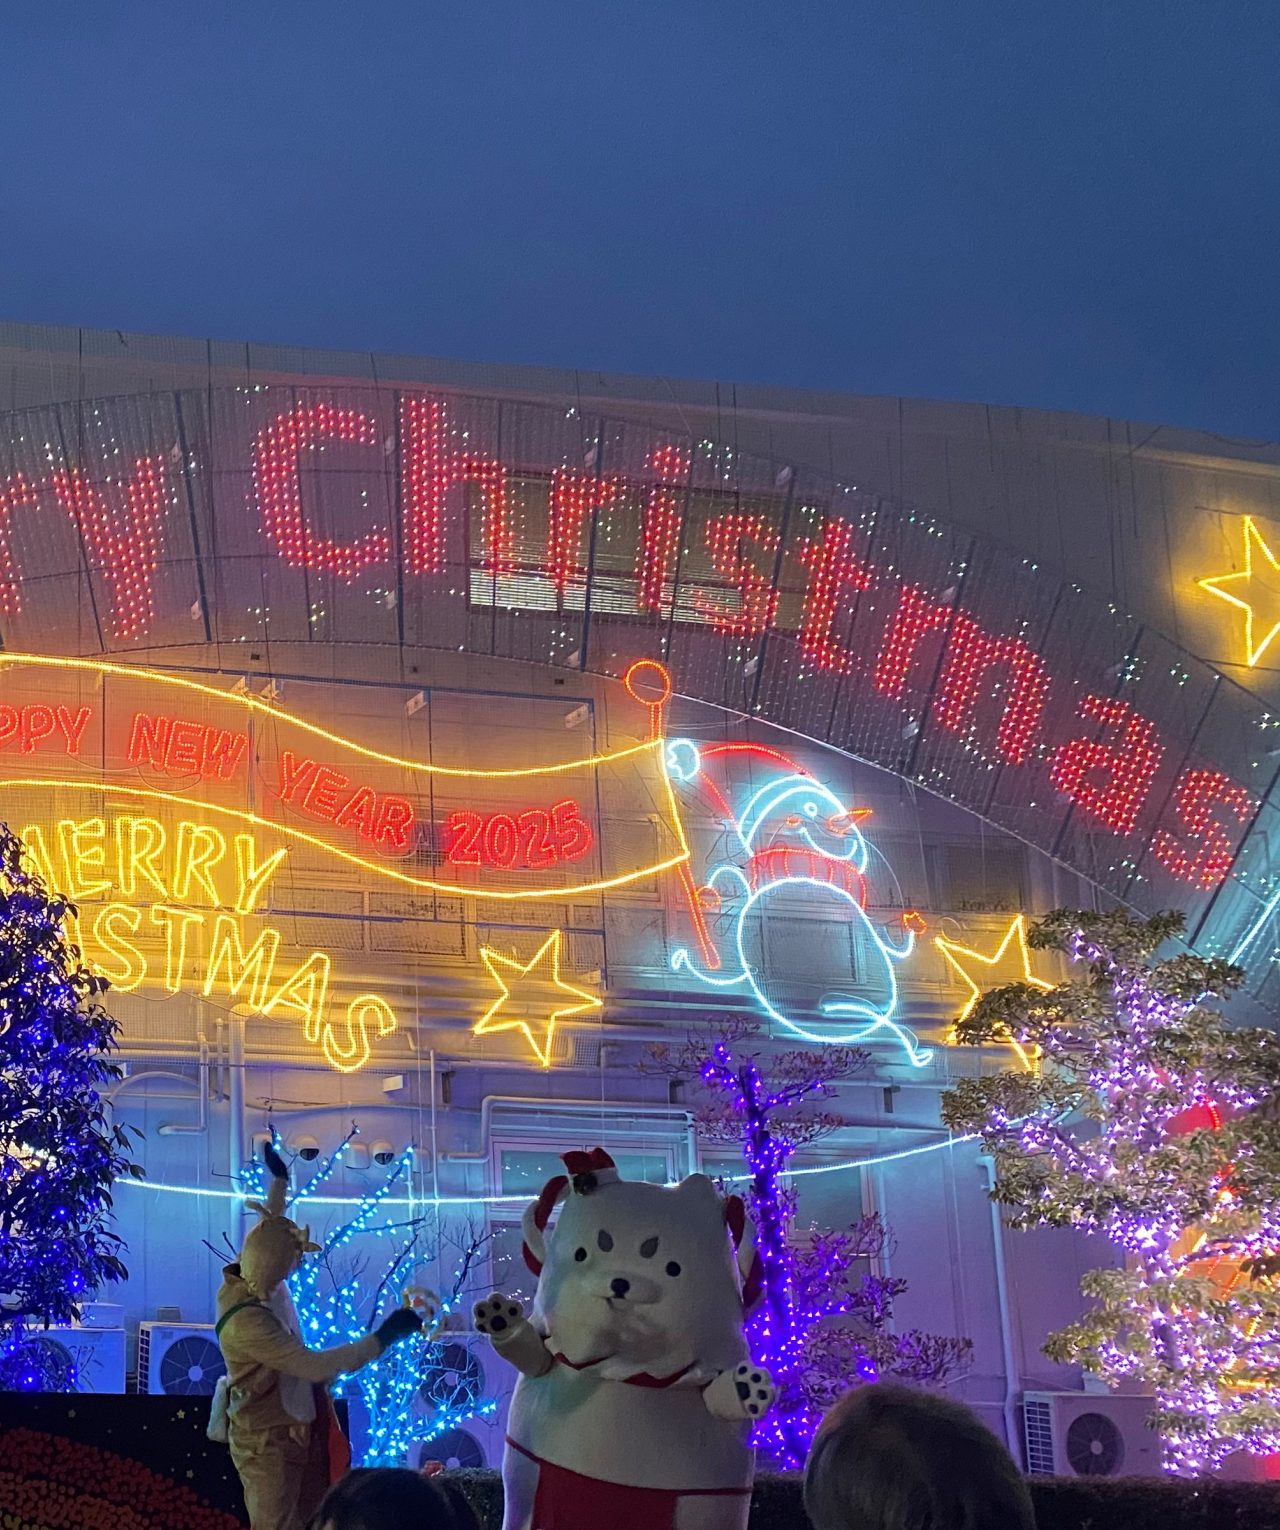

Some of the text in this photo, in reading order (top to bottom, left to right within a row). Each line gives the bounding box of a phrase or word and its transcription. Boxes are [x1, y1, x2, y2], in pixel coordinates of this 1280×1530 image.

[252, 398, 1260, 890] Christmas
[127, 713, 249, 779] NEW
[278, 751, 414, 848] YEAR
[447, 799, 593, 868] 2025
[60, 903, 397, 1073] ISTMAS
